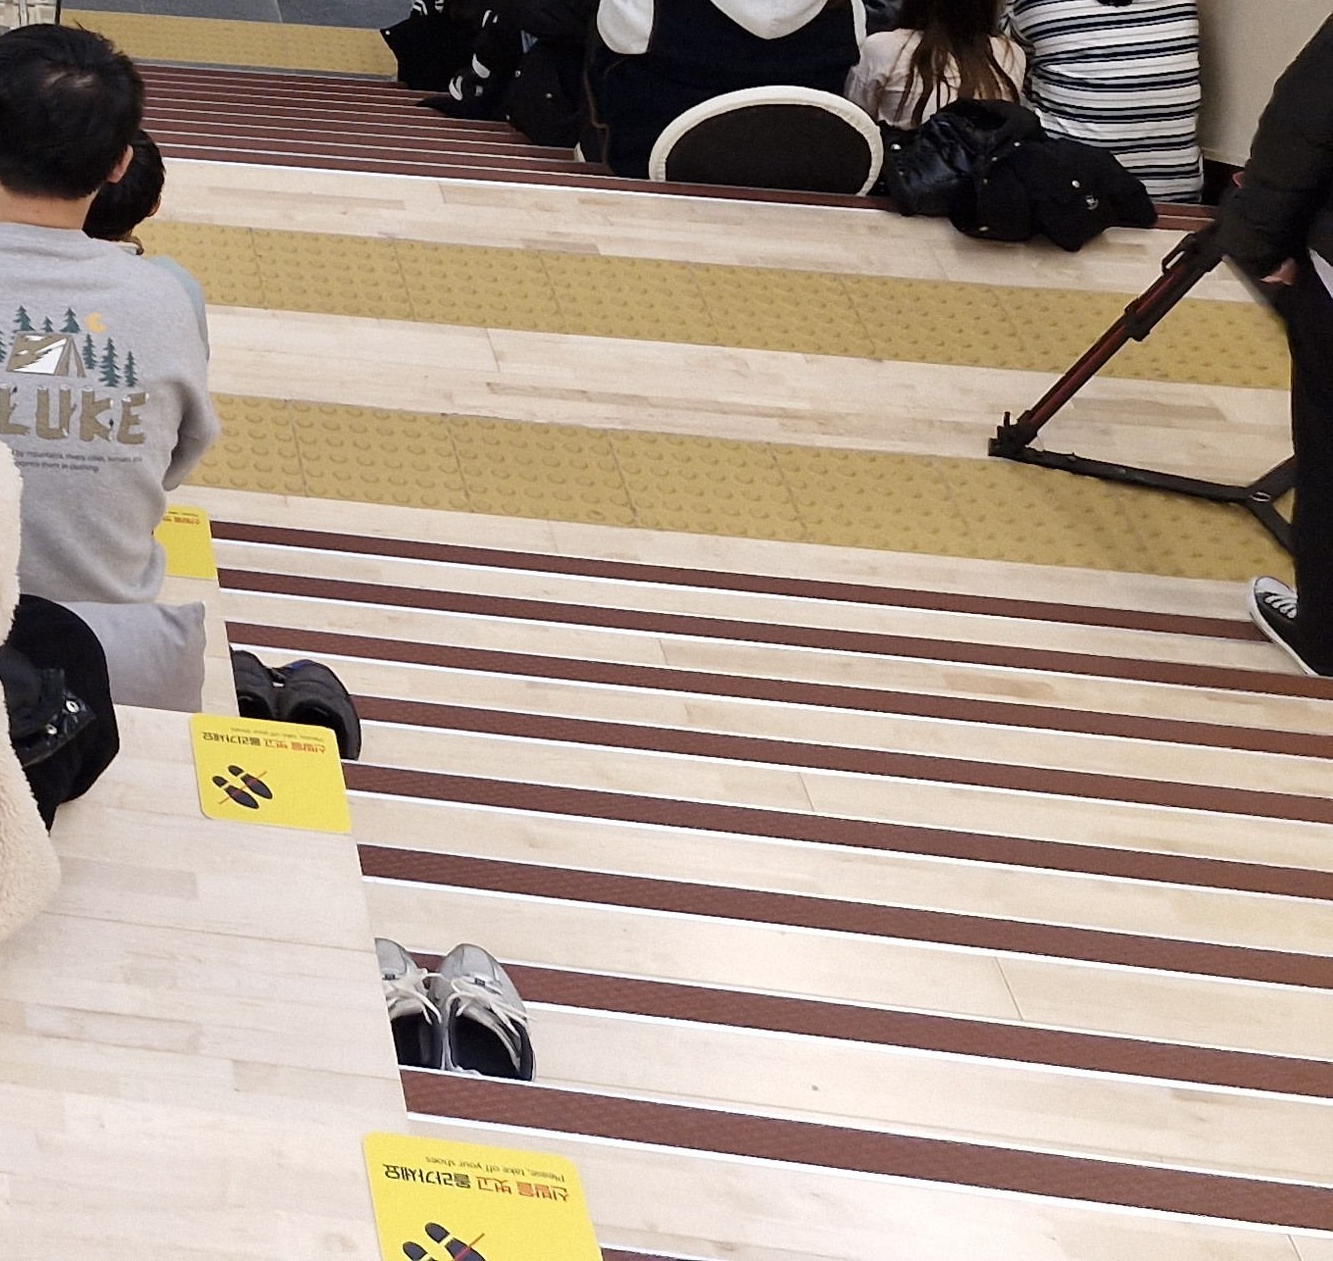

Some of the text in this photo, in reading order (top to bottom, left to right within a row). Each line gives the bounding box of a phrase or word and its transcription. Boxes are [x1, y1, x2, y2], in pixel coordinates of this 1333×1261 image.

[426, 1156, 454, 1167] shoes
[458, 1159, 482, 1170] your
[485, 1163, 498, 1173] off
[503, 1166, 525, 1176] take
[477, 1175, 512, 1196] 벗고
[517, 1182, 569, 1202] 신발을
